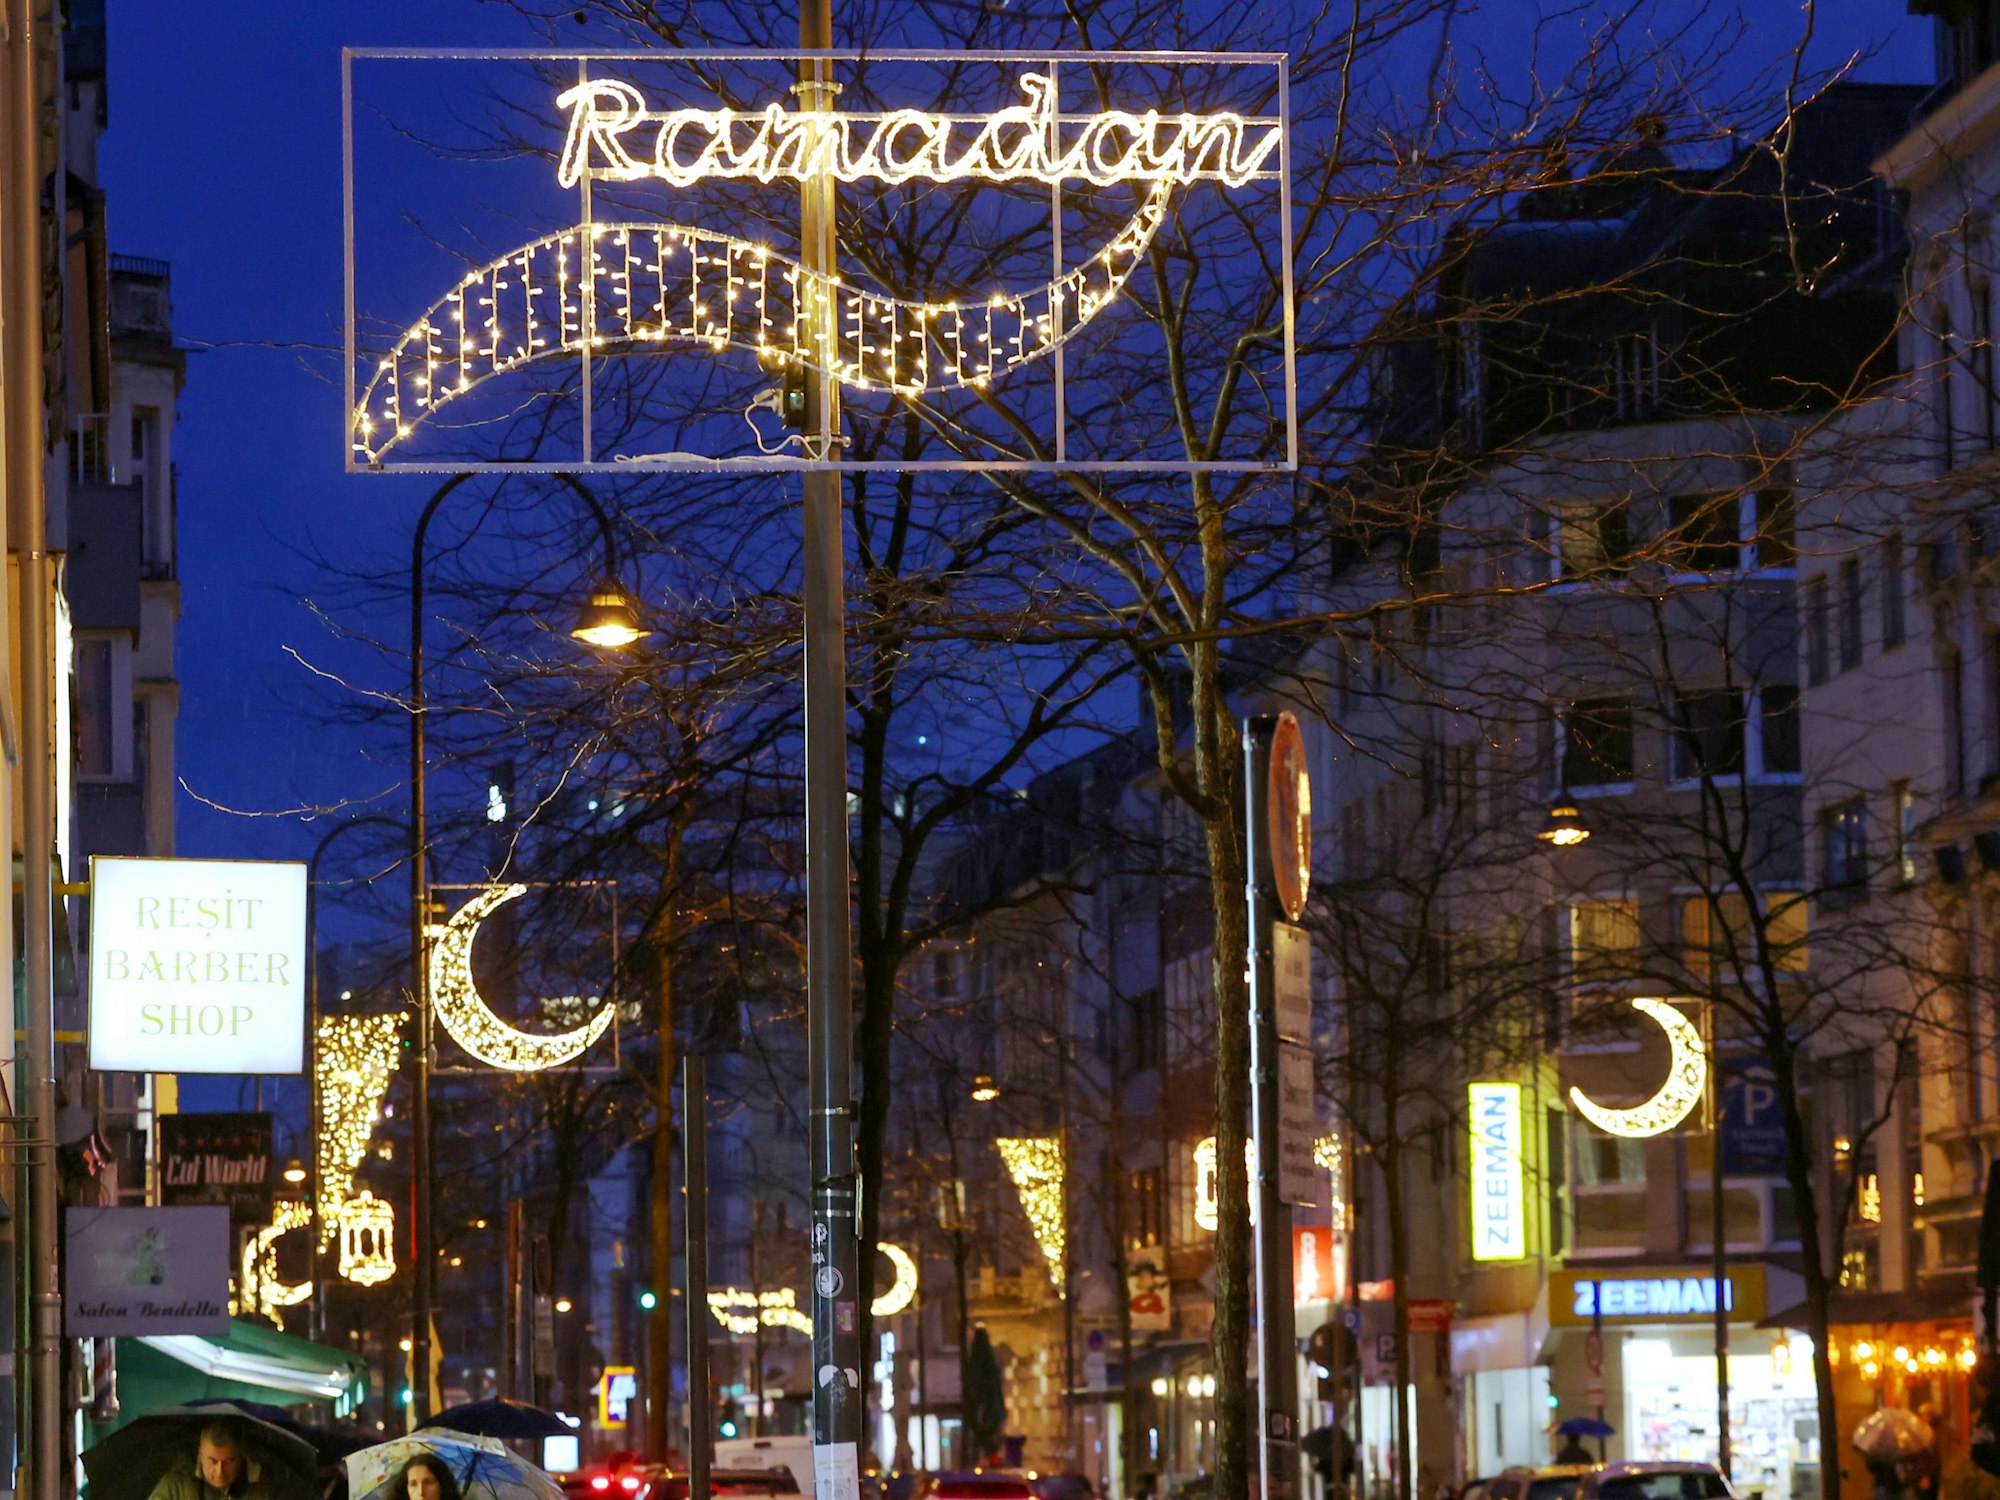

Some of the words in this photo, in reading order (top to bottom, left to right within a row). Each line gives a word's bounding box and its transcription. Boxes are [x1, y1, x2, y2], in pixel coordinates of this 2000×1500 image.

[556, 73, 1283, 188] Ramadan
[104, 949, 290, 986] BARBER
[140, 1003, 253, 1036] SHOP
[166, 1154, 200, 1185] Cut
[204, 1152, 267, 1184] World
[1484, 1095, 1510, 1245] ZEEMAN
[73, 1302, 128, 1318] Salon
[1573, 1278, 1733, 1317] ZEEMAN
